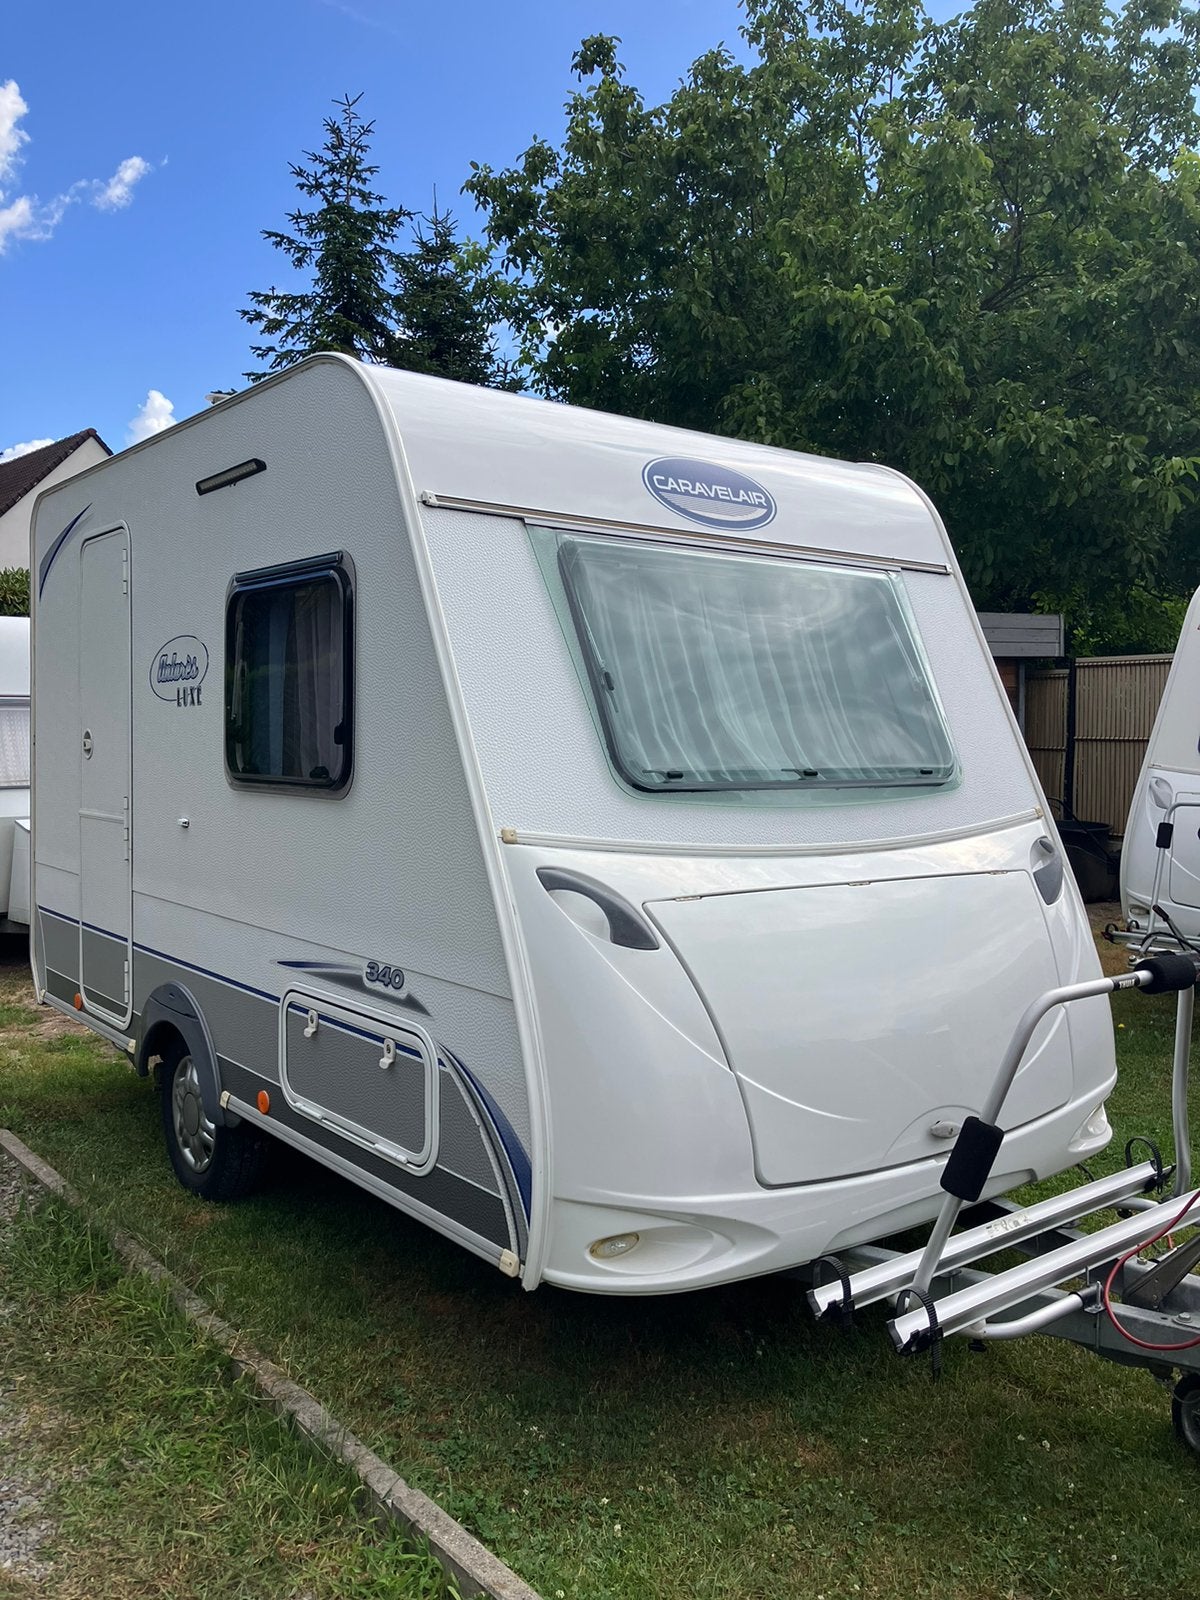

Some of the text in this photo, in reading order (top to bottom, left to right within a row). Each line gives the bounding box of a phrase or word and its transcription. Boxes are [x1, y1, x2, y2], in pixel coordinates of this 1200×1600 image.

[652, 474, 767, 506] CARAVELAIR
[177, 685, 202, 707] LUXE
[365, 961, 405, 990] 340
